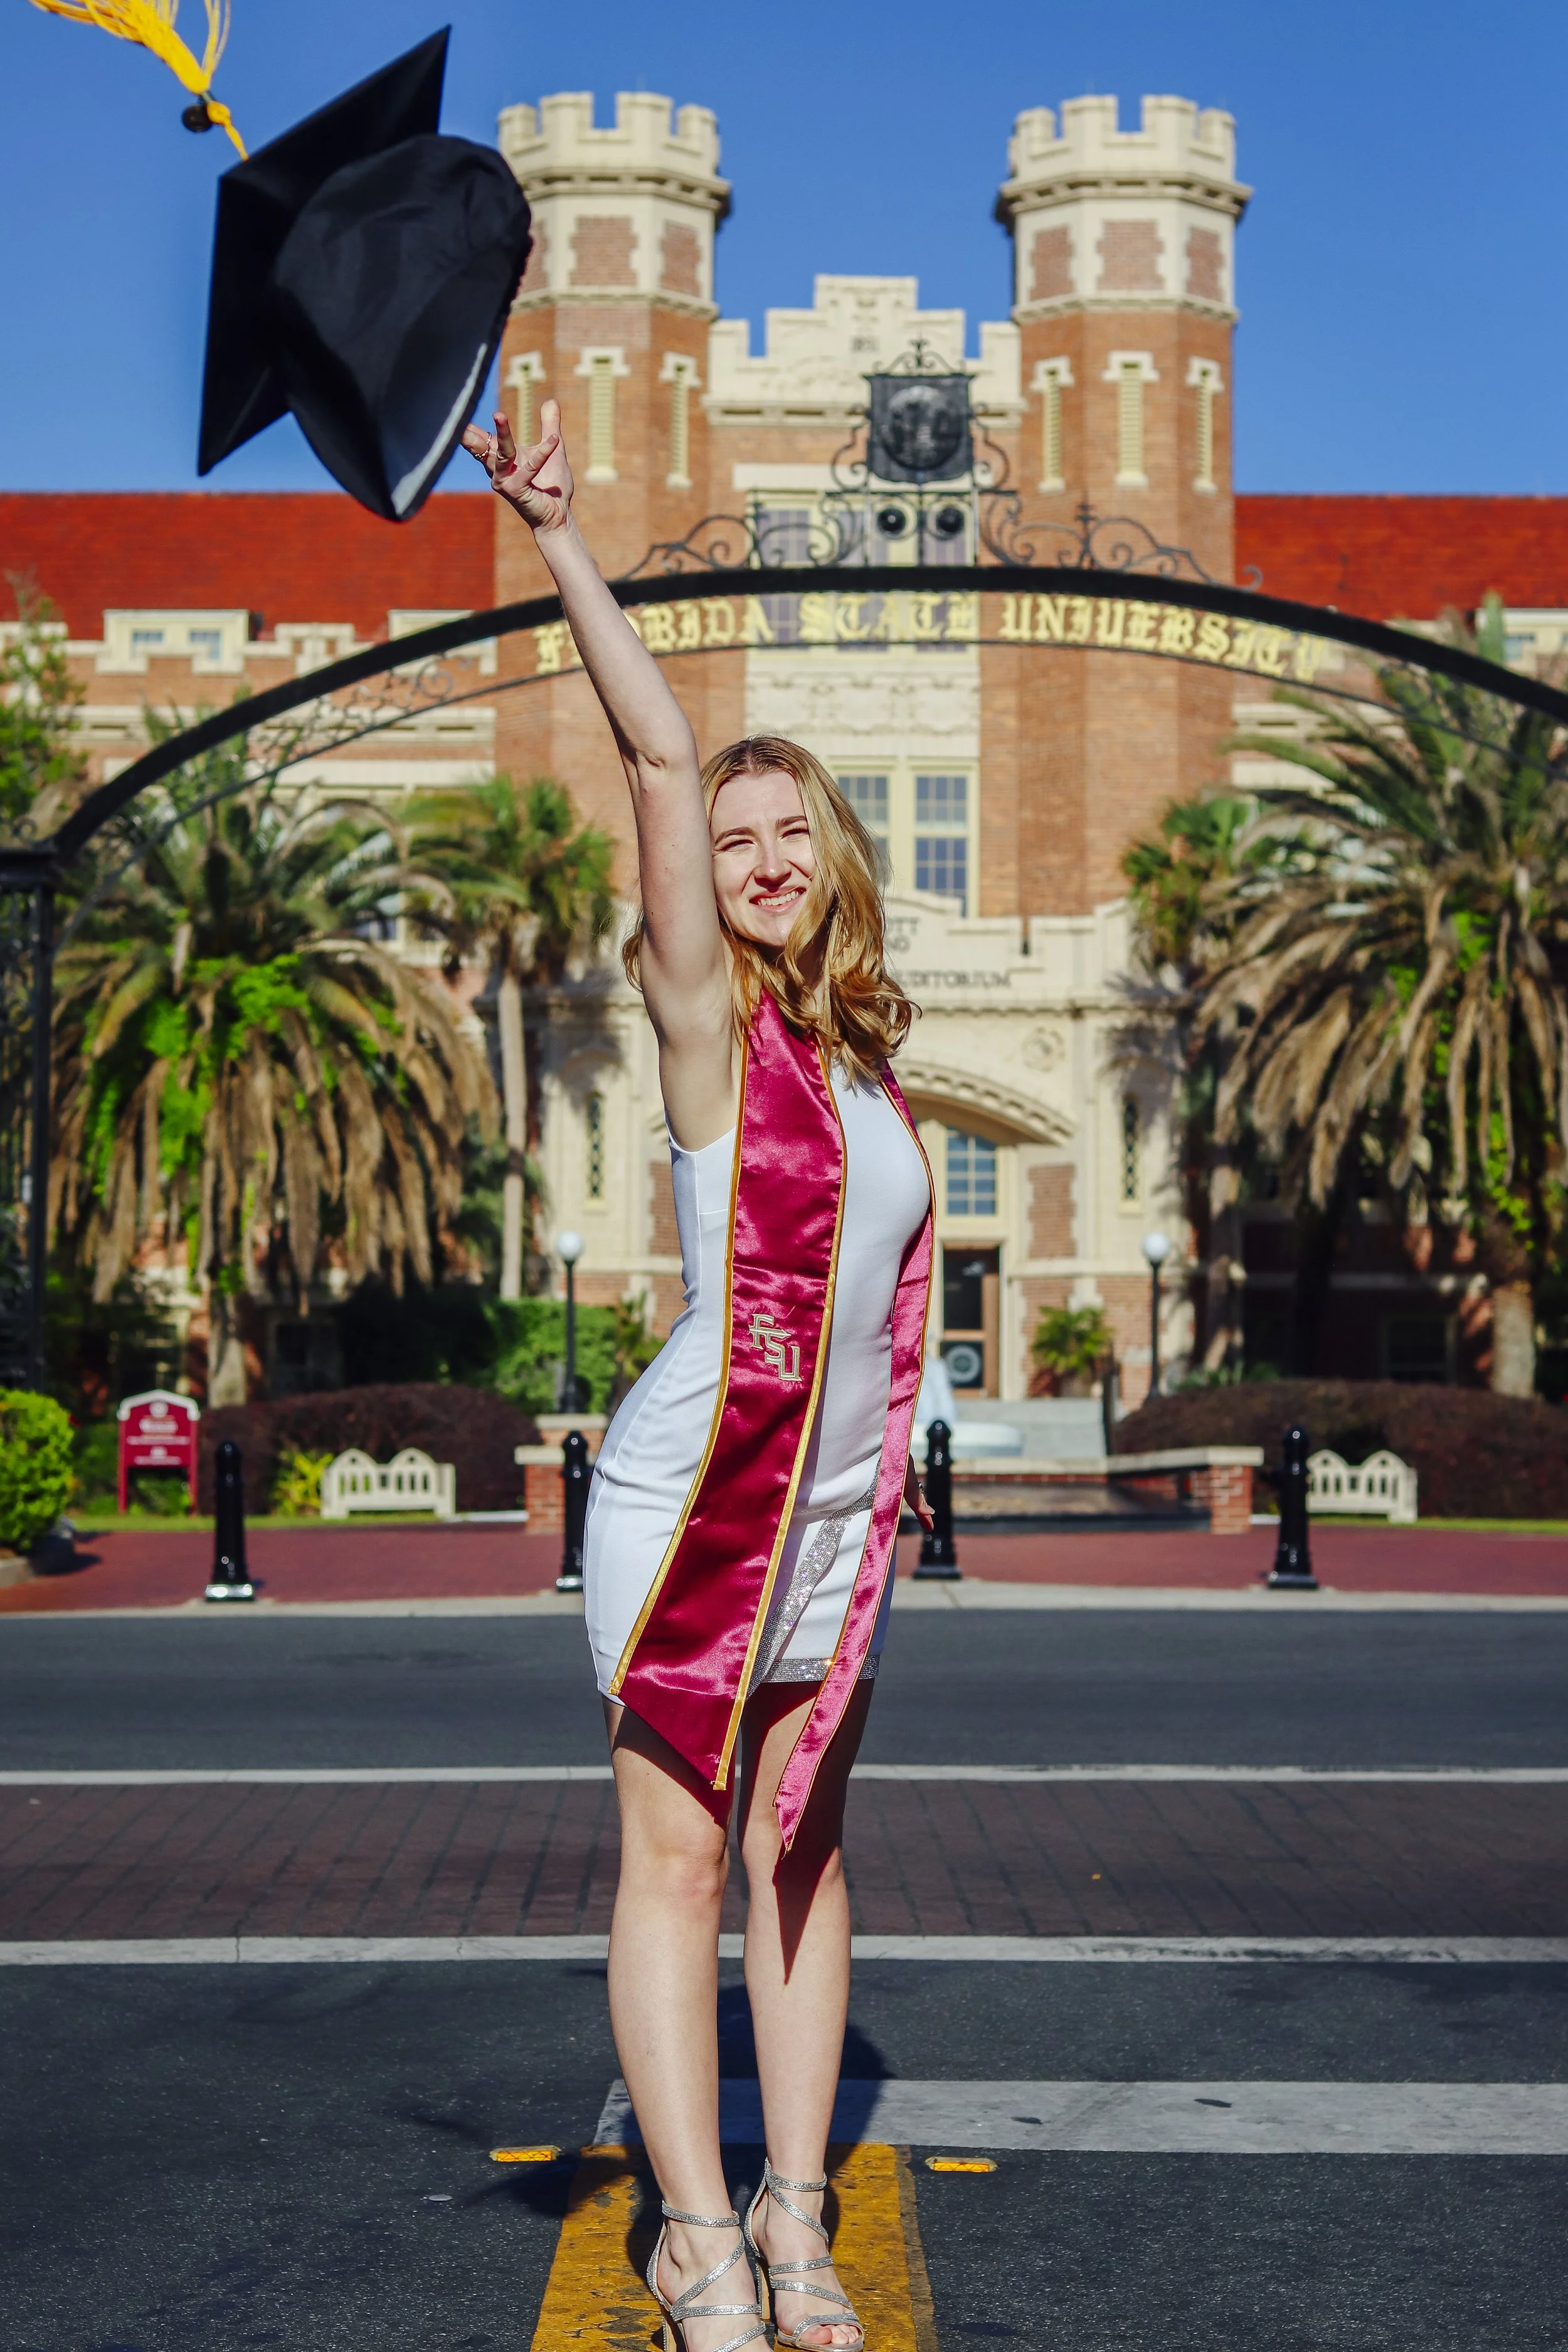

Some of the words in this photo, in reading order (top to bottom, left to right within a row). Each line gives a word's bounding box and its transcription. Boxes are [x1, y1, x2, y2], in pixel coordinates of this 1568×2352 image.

[532, 593, 775, 675] FRIDA
[798, 590, 979, 643] STATE
[999, 591, 1325, 682] UNIVERSITY
[748, 1313, 802, 1381] FSU
